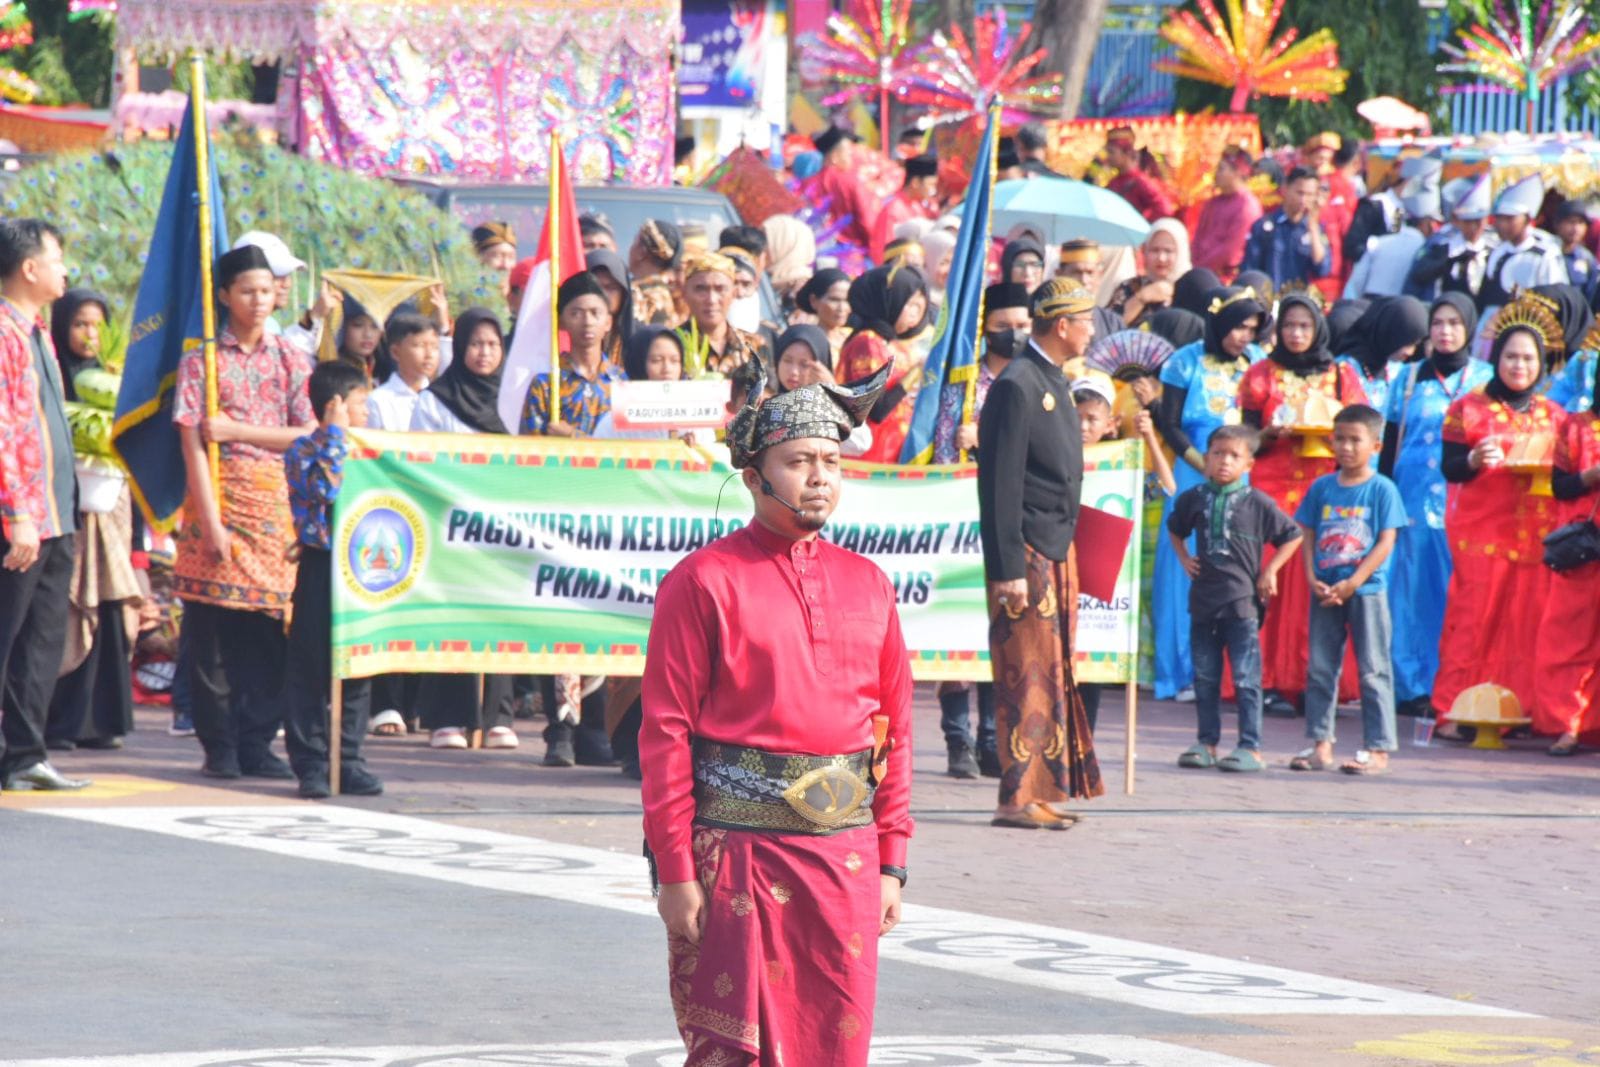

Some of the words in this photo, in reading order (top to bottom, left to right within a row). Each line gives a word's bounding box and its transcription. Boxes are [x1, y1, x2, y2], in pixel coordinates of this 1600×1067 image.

[627, 408, 687, 418] PAGUYUBAN
[691, 407, 719, 417] JAWA
[447, 508, 614, 551] PAGUYUBAN
[950, 520, 982, 554] JA
[535, 563, 612, 600] PKMJ
